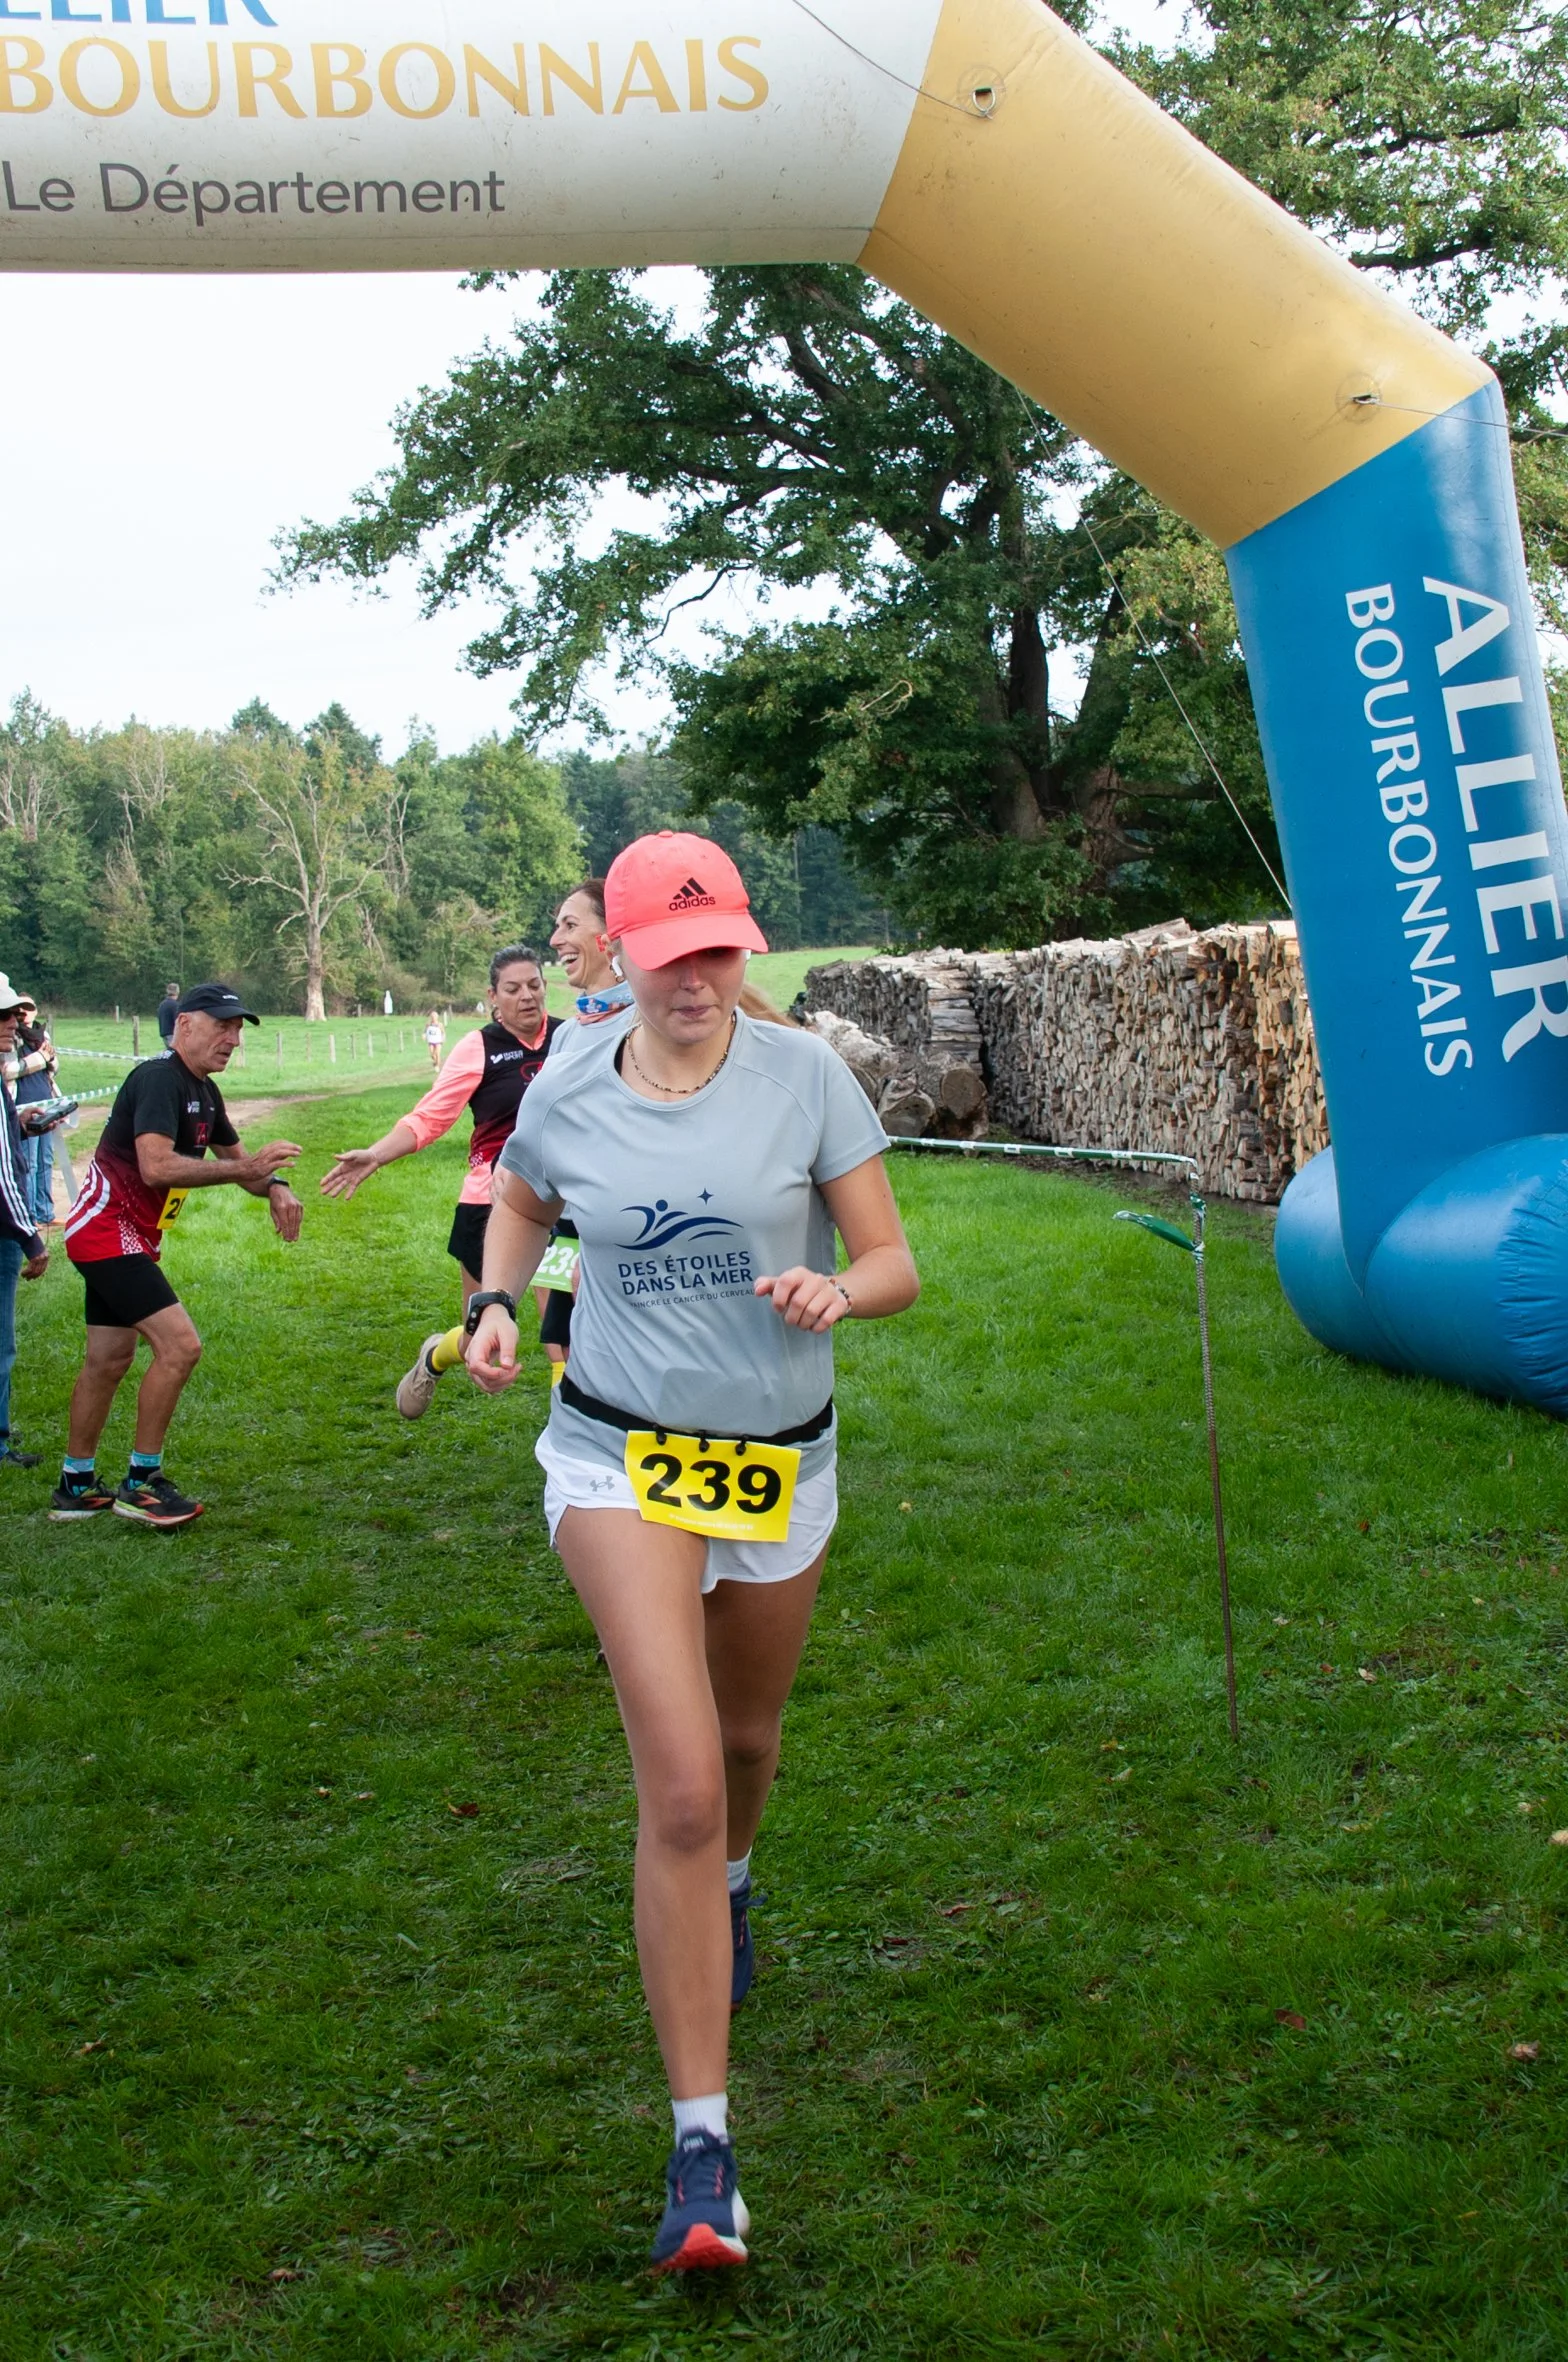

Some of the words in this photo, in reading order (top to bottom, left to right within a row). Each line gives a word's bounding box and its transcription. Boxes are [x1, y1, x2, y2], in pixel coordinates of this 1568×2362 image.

[0, 35, 770, 119] BOURBONNAIS
[3, 160, 76, 212] Le
[100, 162, 506, 227] Département
[1345, 583, 1473, 1077] BOURBONNAIS
[1423, 576, 1568, 1063] ALLIER
[668, 896, 716, 911] adidas
[164, 1197, 185, 1219] 2
[618, 1259, 657, 1278] DES
[666, 1251, 751, 1273] ÉTOILES
[621, 1275, 675, 1296] DANS
[681, 1272, 706, 1290] LA
[711, 1268, 753, 1286] MER
[673, 1294, 705, 1304] CANCER
[640, 1453, 782, 1514] 239
